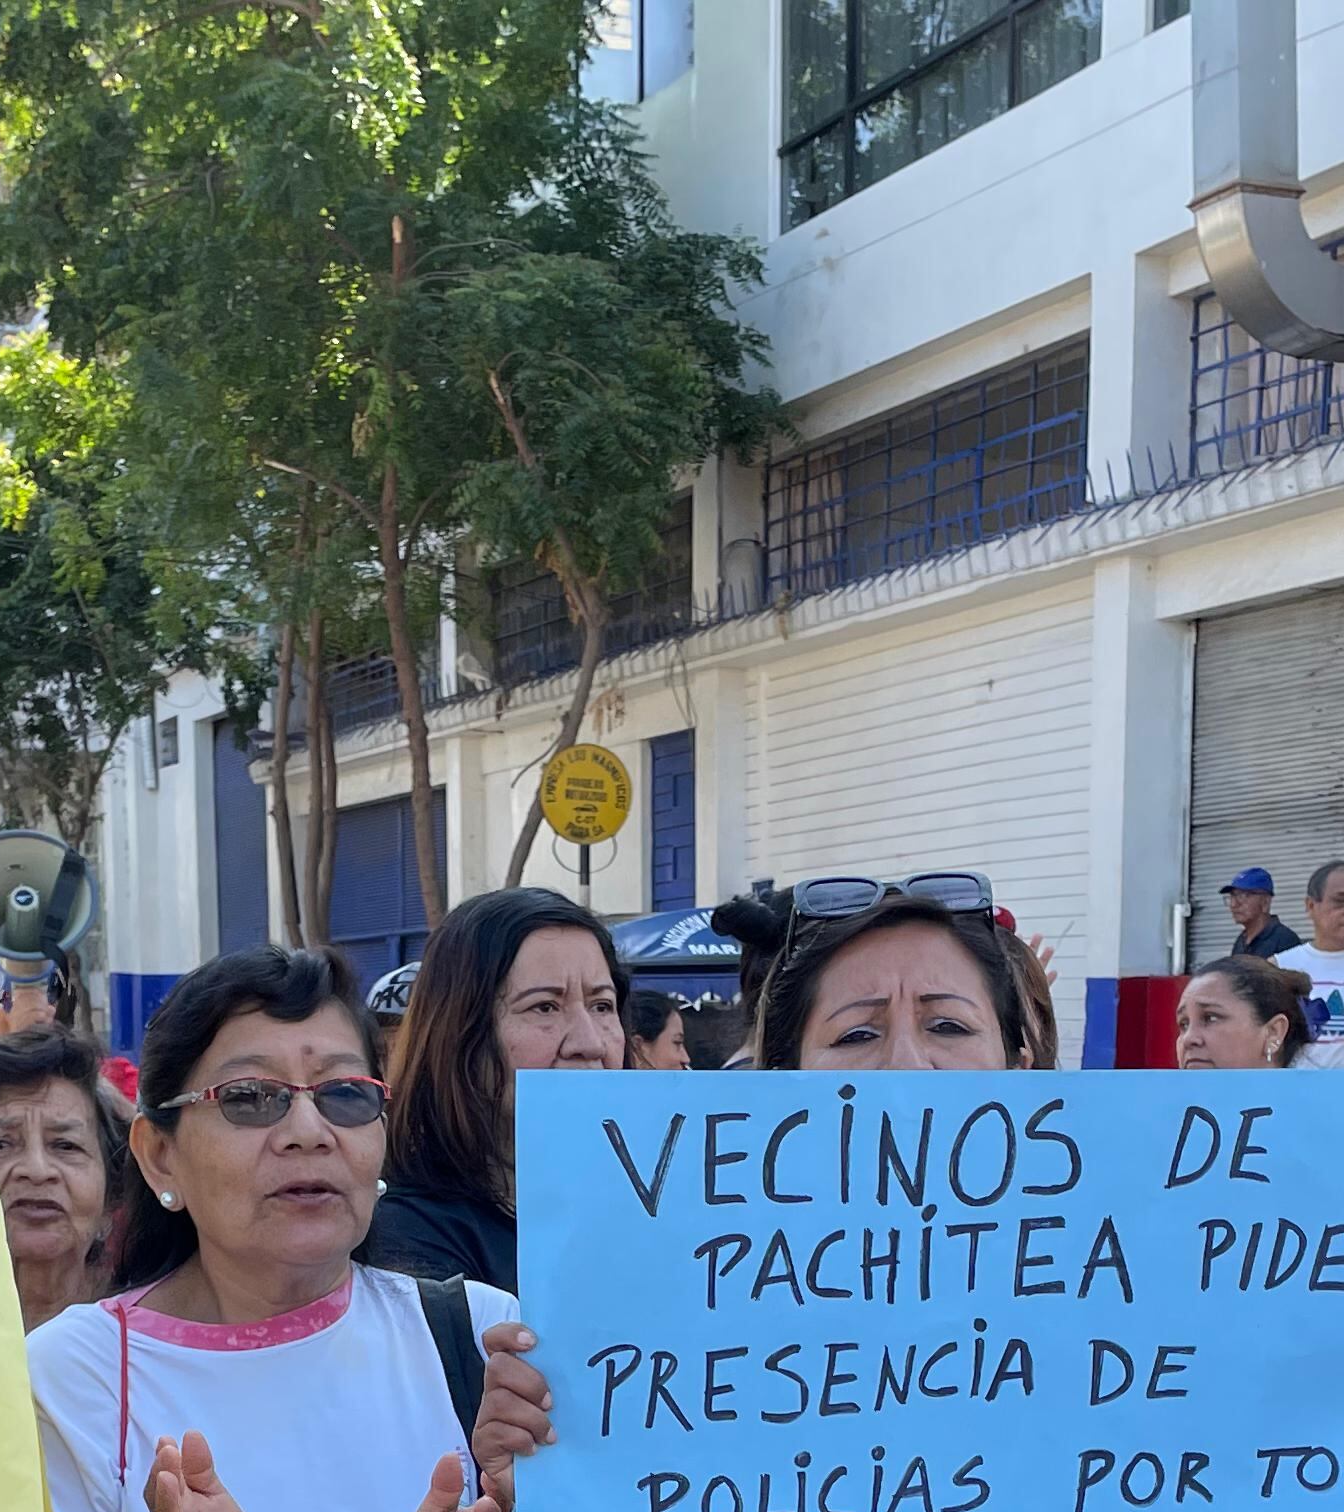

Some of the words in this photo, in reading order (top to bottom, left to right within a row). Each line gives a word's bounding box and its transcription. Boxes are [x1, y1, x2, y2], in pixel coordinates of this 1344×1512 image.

[688, 943, 742, 955] MAR
[603, 1084, 1081, 1217] VECINOS
[1165, 1106, 1272, 1188] DE
[695, 1204, 1133, 1309] PACHITEA
[588, 1318, 1033, 1436] PRESENCIA
[1089, 1340, 1195, 1405] DE
